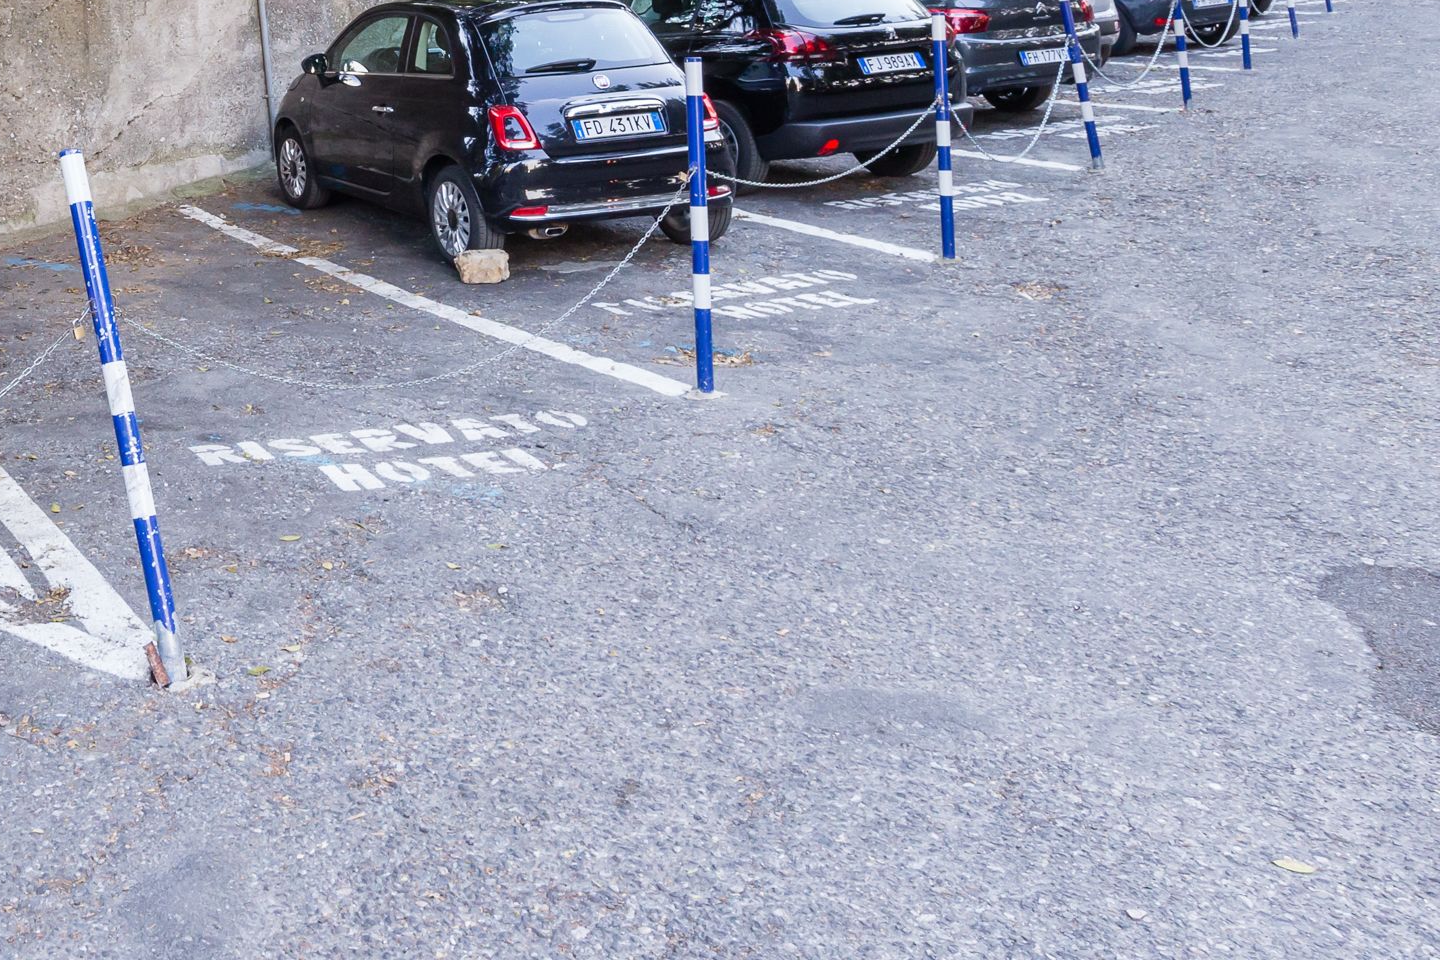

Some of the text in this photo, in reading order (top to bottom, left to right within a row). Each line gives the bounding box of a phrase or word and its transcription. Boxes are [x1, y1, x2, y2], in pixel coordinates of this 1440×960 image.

[887, 54, 918, 69] 989AX
[1027, 50, 1039, 63] FH
[584, 115, 652, 136] FD 431KV
[188, 410, 588, 467] RISERVATO
[317, 446, 567, 492] HOTEL
